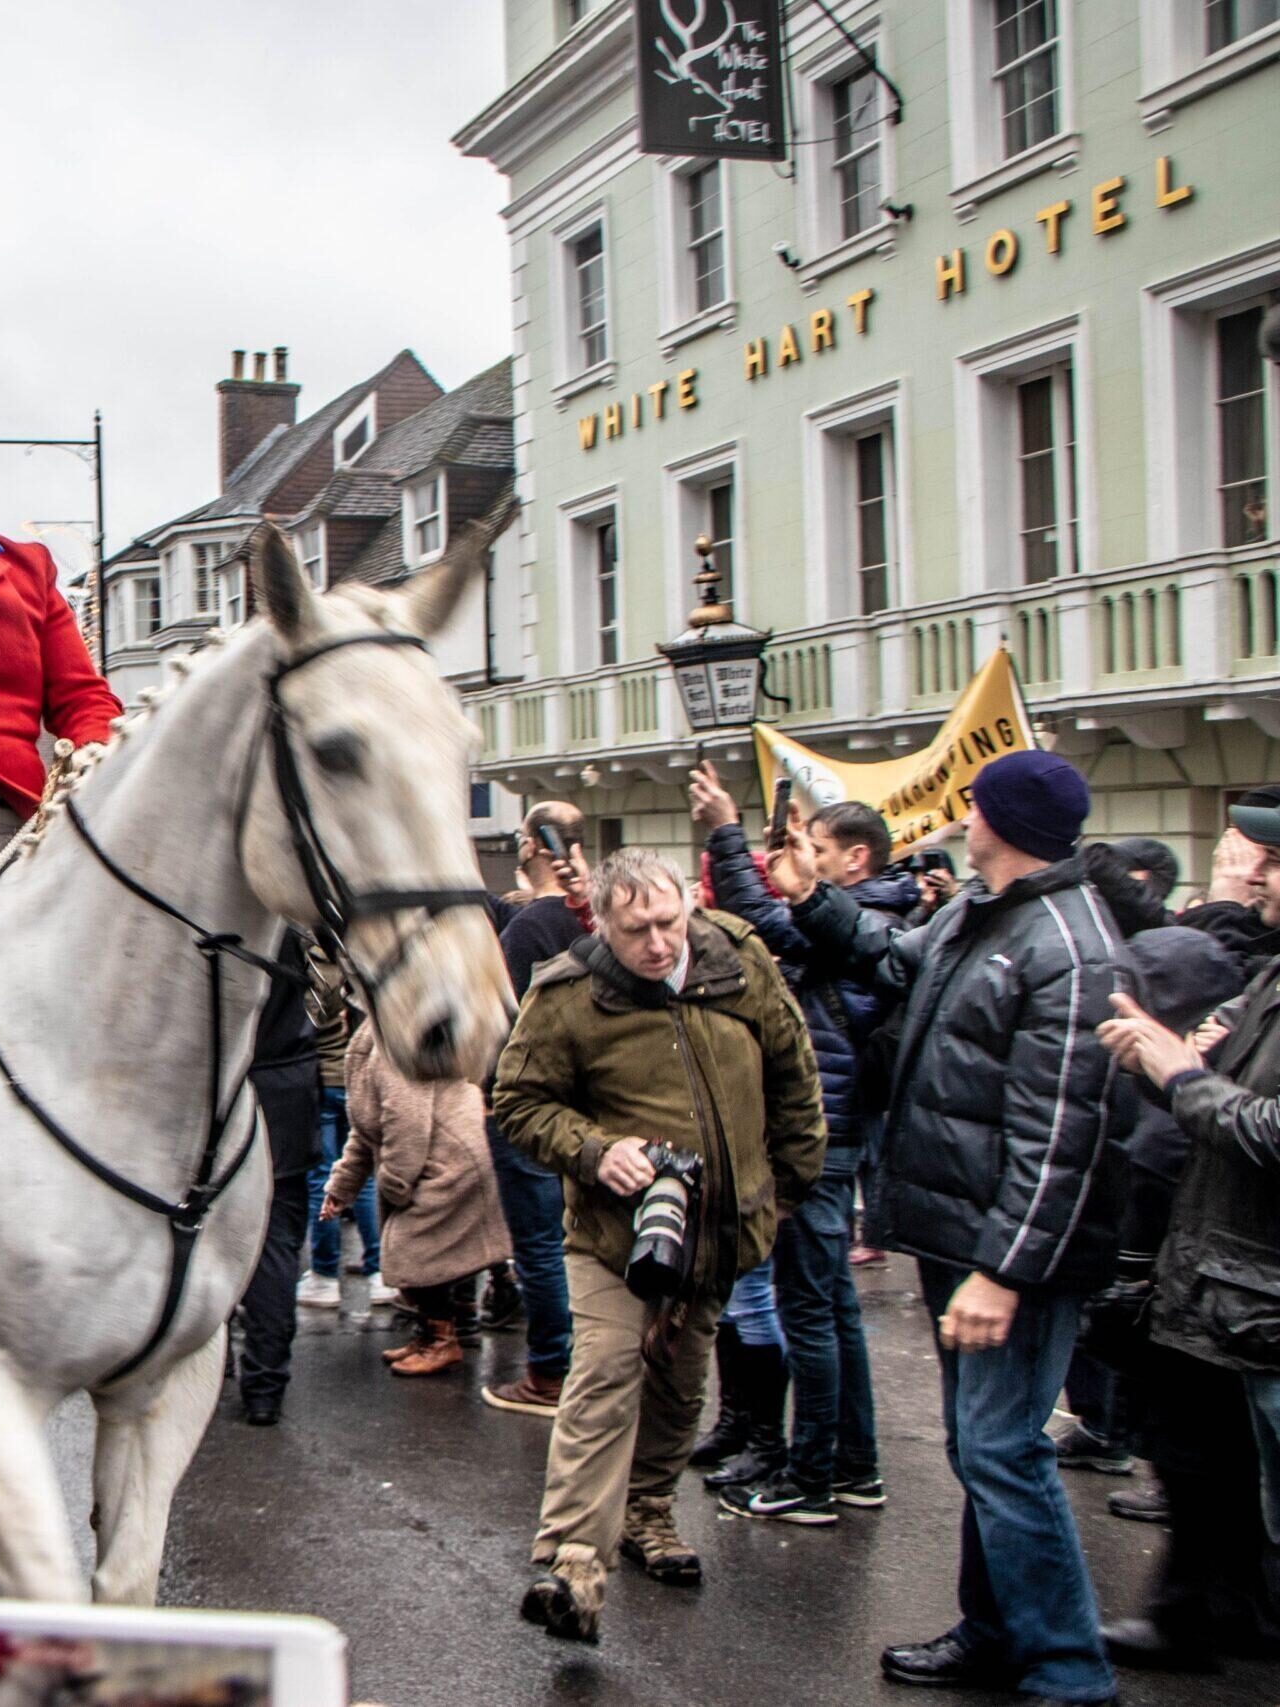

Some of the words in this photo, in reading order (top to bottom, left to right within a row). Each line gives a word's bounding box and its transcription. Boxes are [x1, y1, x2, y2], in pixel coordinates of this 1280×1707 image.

[713, 42, 768, 70] White
[721, 72, 768, 101] Hart
[712, 116, 776, 143] HOTEL
[578, 367, 698, 451] WHITE
[743, 287, 874, 381] HART
[935, 154, 1194, 301] HOTEL
